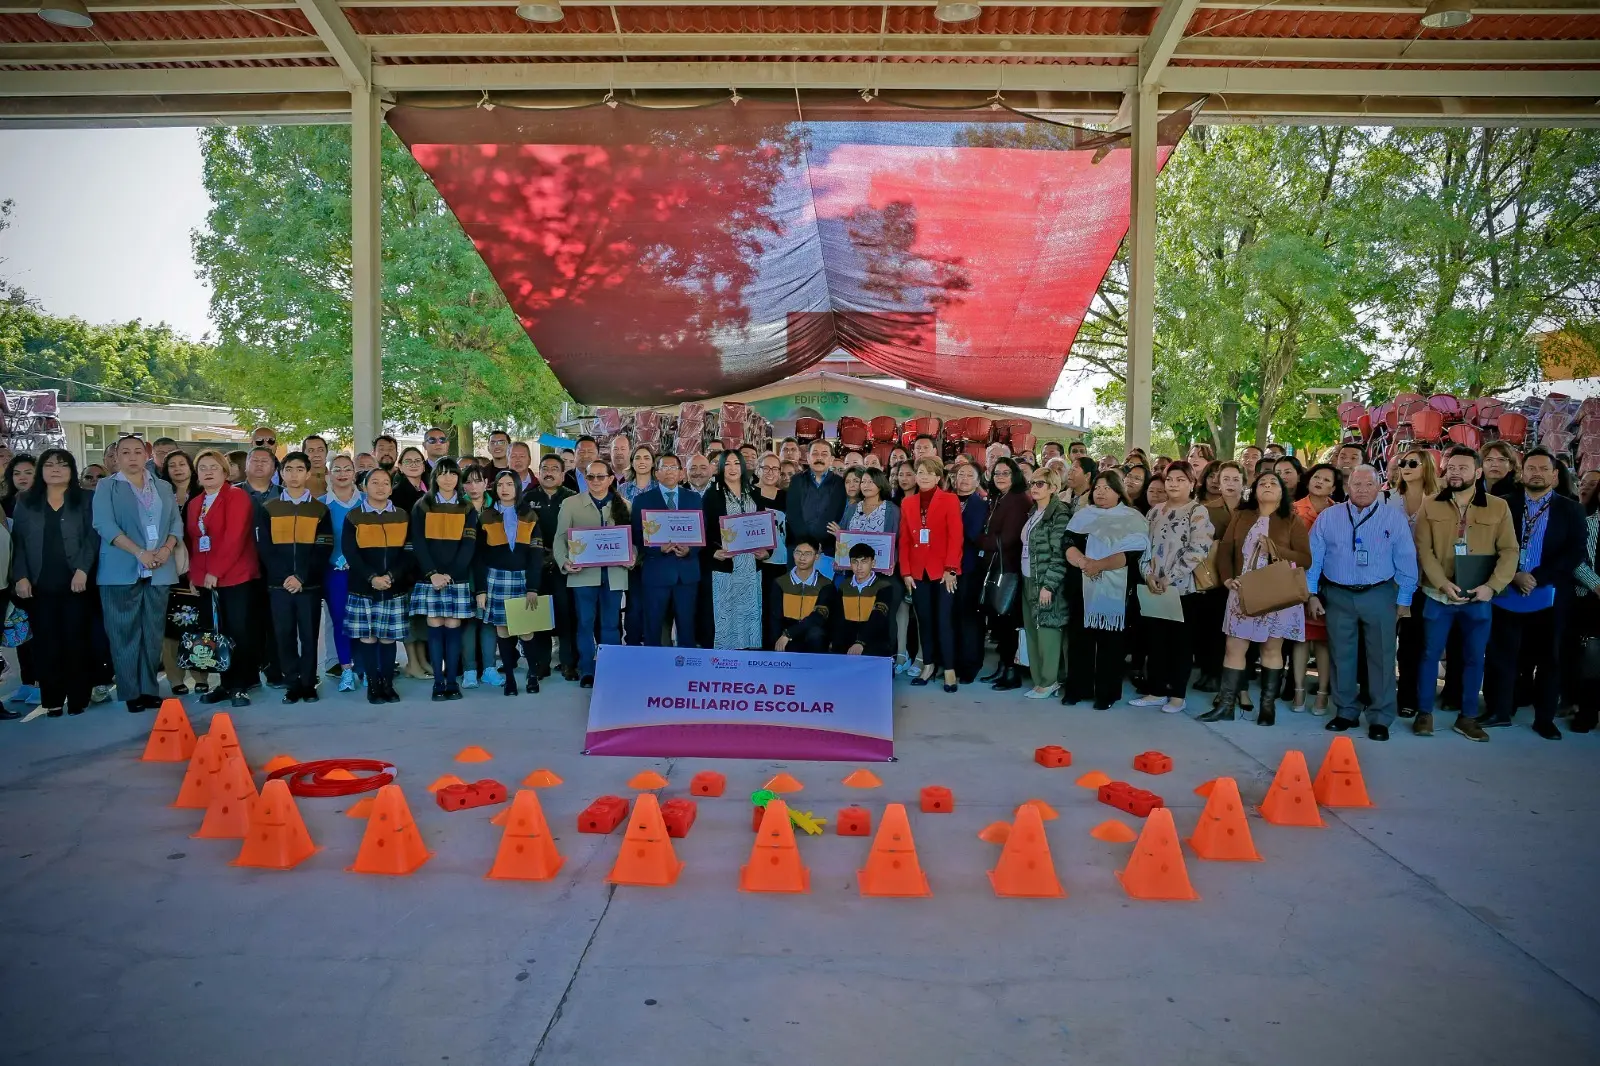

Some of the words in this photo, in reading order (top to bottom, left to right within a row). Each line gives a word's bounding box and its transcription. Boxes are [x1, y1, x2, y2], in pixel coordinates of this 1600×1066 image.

[795, 395, 839, 404] EDIFICIO
[843, 395, 849, 404] 3
[745, 528, 766, 537] VALE
[688, 680, 768, 695] ENTREGA
[773, 684, 796, 696] DE
[647, 696, 749, 711] MOBILIARIO
[753, 700, 835, 714] ESCOLAR
